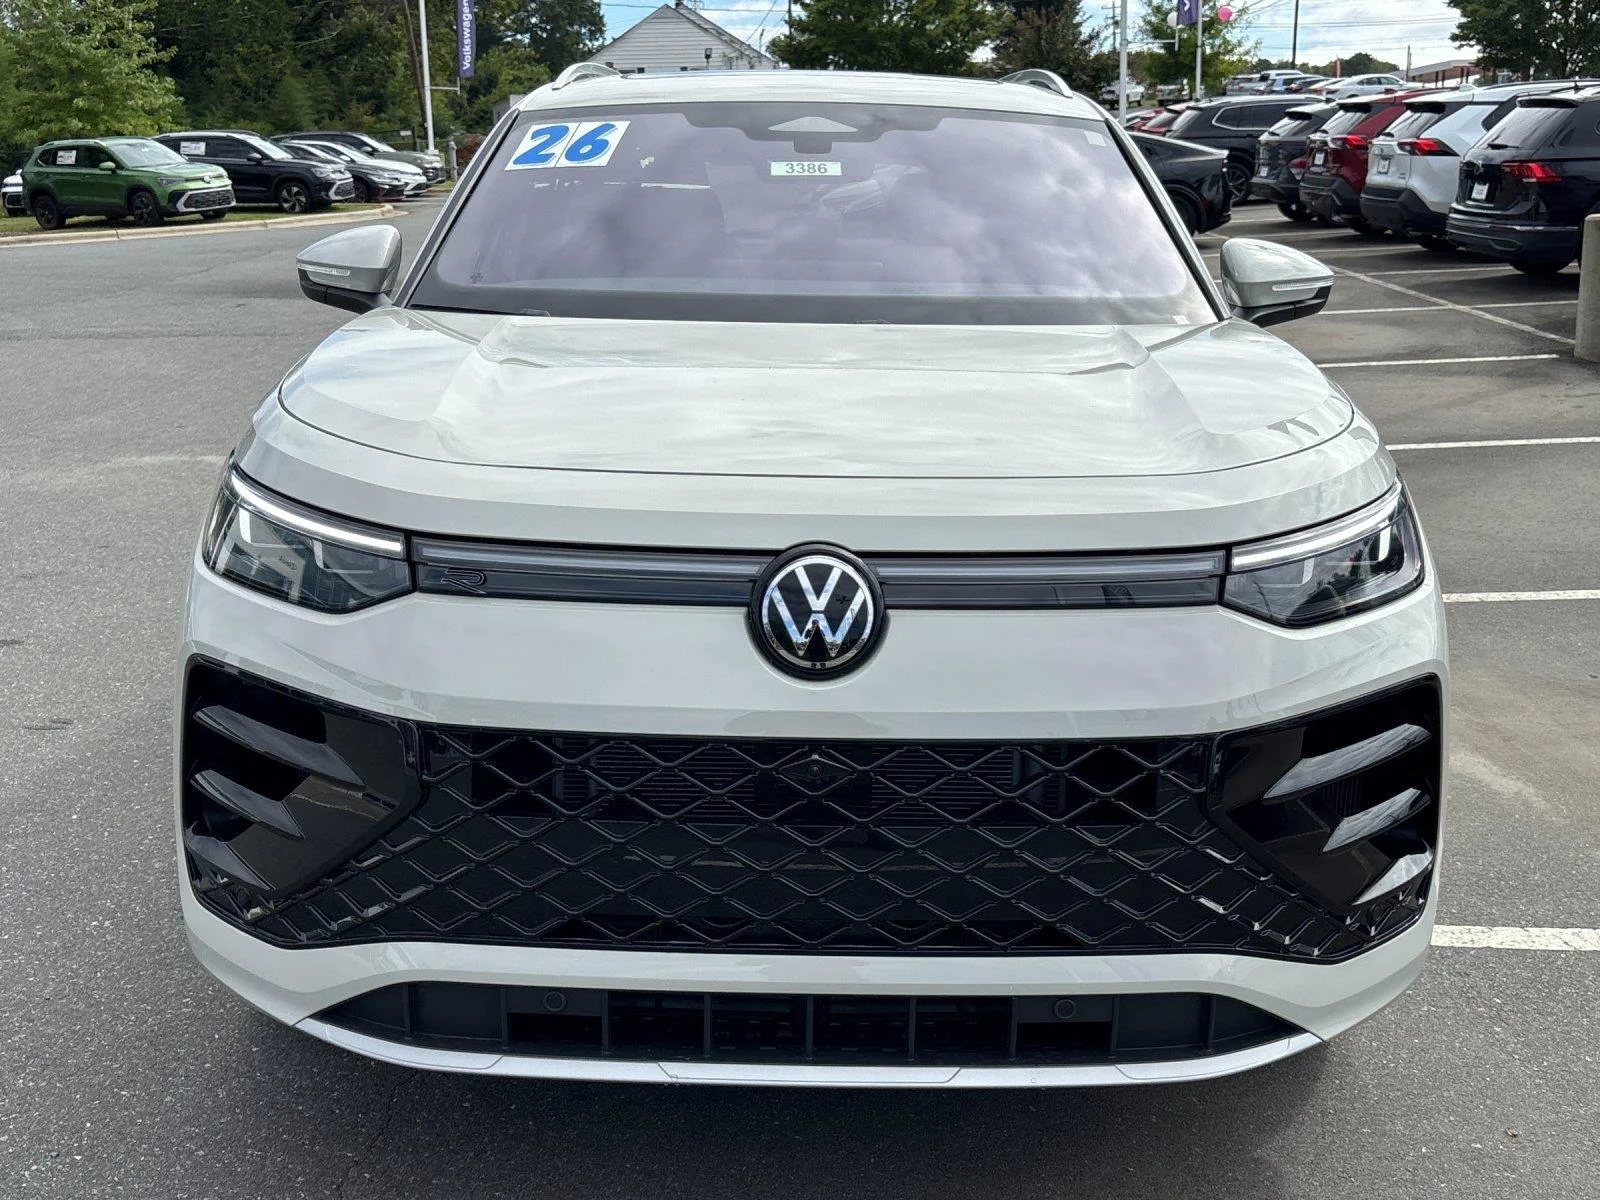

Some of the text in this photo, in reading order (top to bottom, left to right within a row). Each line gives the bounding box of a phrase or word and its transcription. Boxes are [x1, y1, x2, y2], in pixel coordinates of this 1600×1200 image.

[462, 0, 472, 70] Volkswagen
[512, 122, 617, 165] 26
[785, 162, 828, 174] 3386
